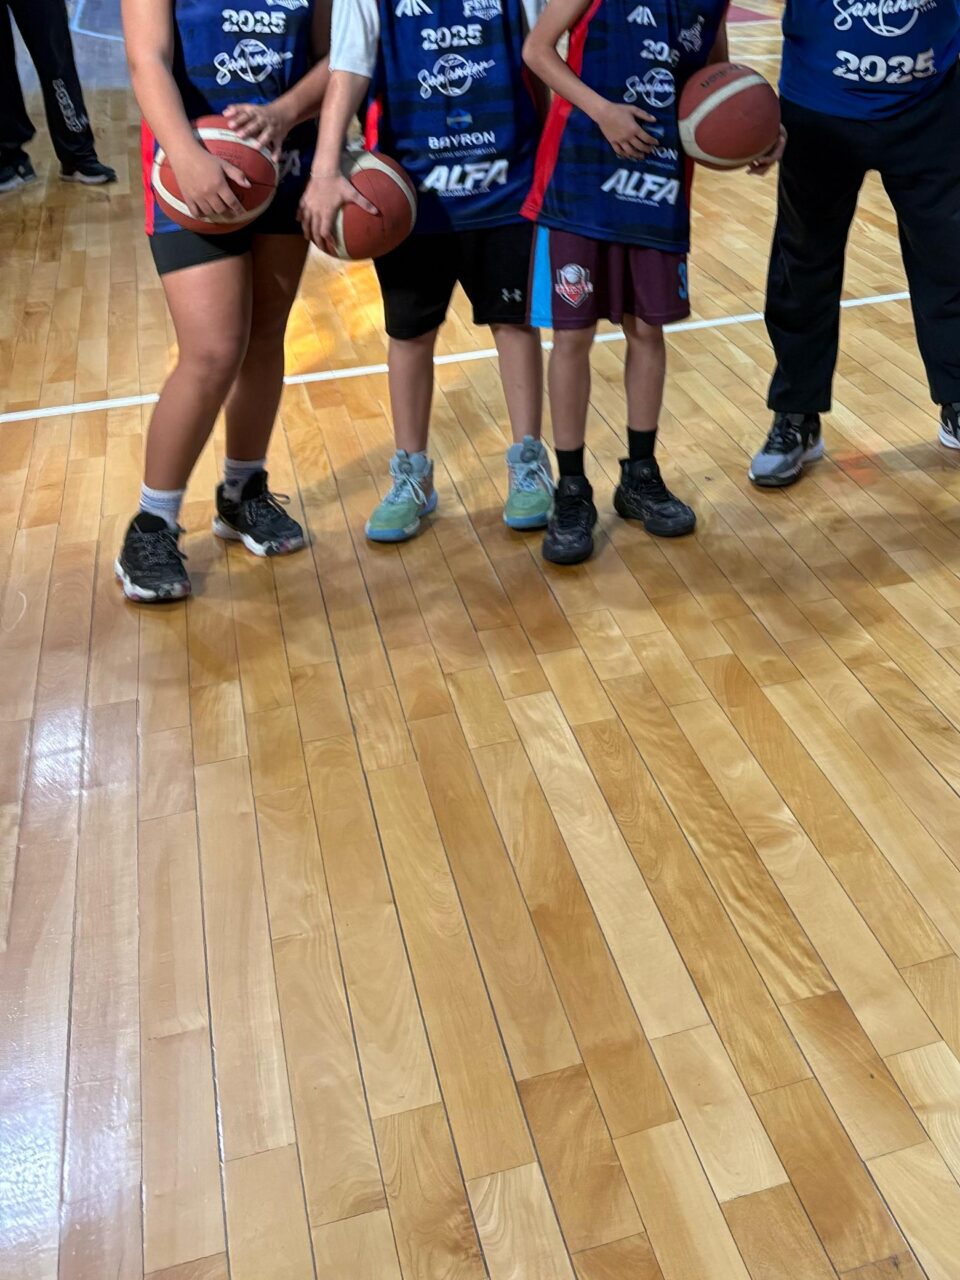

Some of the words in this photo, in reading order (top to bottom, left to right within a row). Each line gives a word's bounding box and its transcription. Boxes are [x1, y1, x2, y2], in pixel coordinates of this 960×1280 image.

[222, 9, 286, 34] 2025
[421, 24, 483, 50] 2025
[832, 47, 937, 84] 2025
[428, 131, 496, 149] BAYRON
[418, 159, 509, 193] ALFA
[600, 169, 680, 205] ALFA
